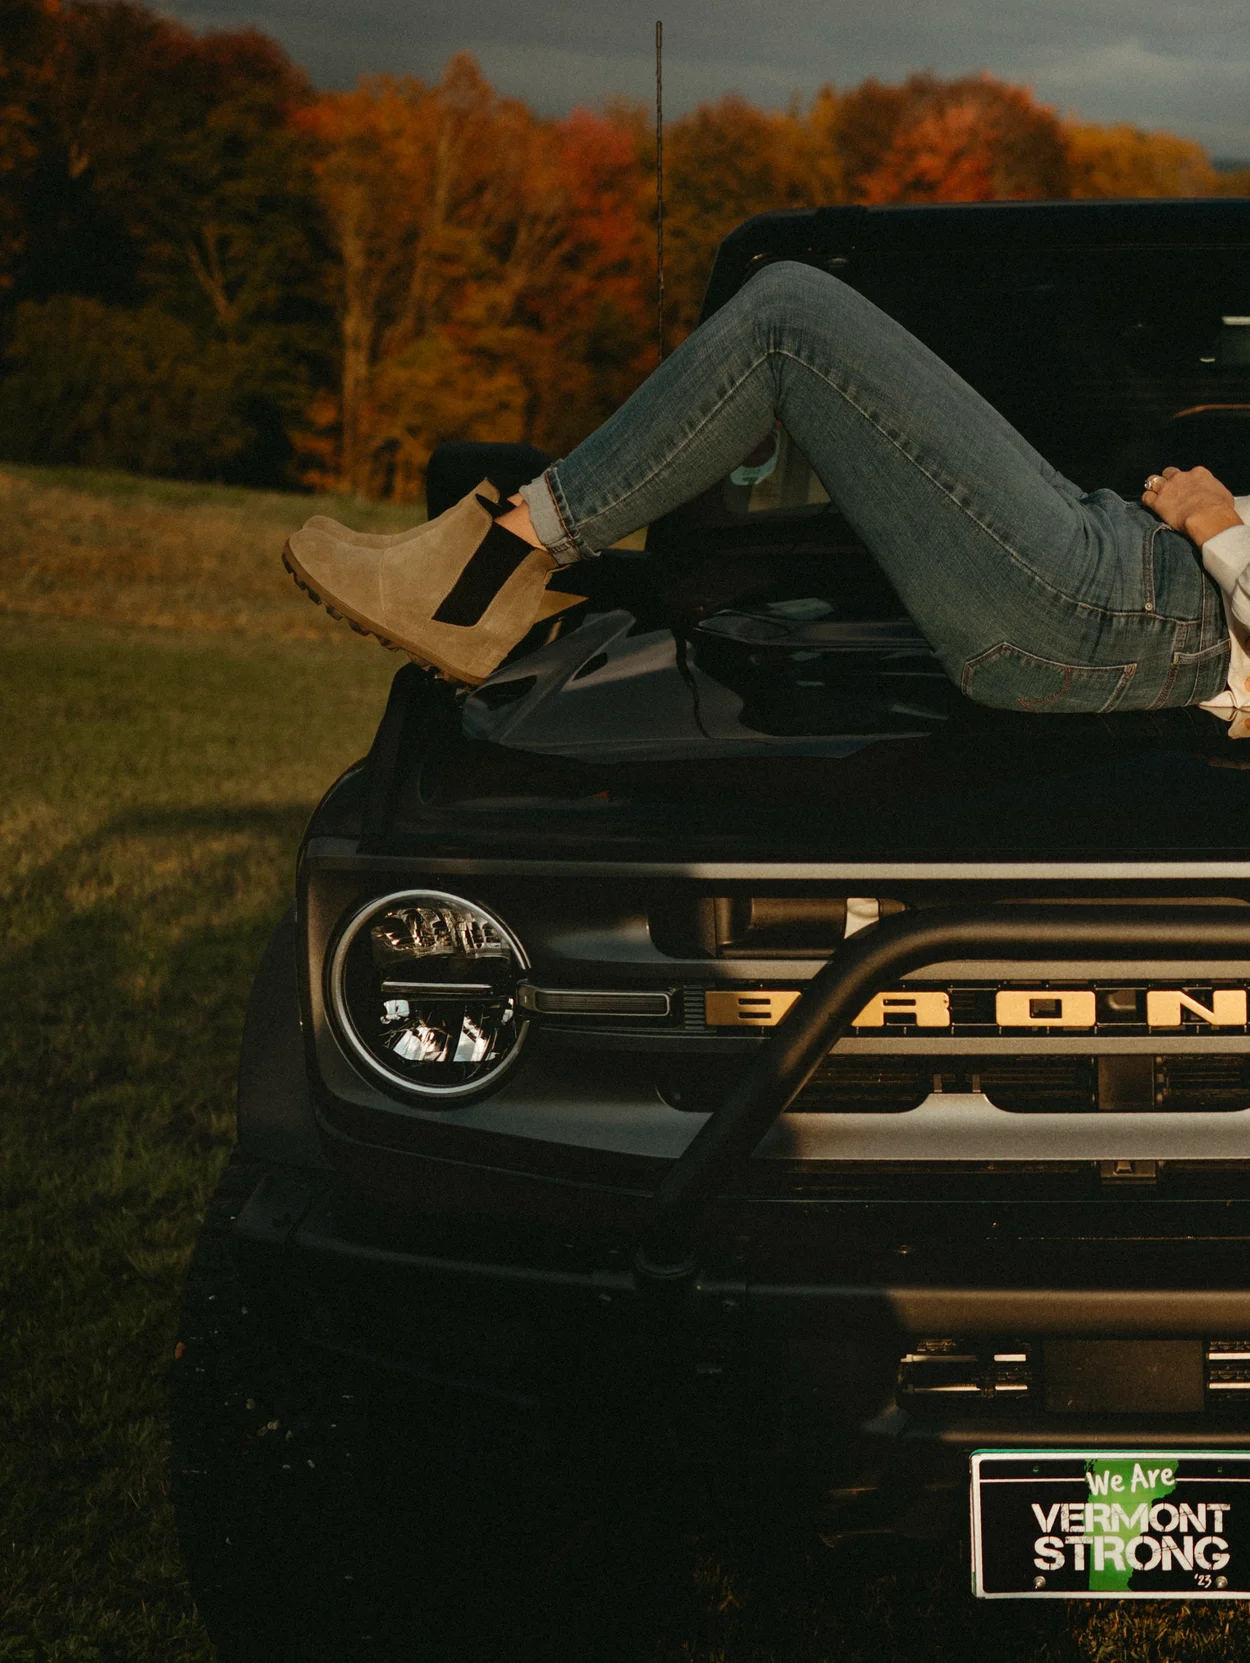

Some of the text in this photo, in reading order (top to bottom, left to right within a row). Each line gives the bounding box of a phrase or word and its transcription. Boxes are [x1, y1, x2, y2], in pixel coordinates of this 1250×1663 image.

[1086, 1462, 1177, 1496] We Are
[1031, 1503, 1231, 1533] VERMONT
[1033, 1536, 1231, 1571] STRONG
[1194, 1573, 1212, 1588] '23
